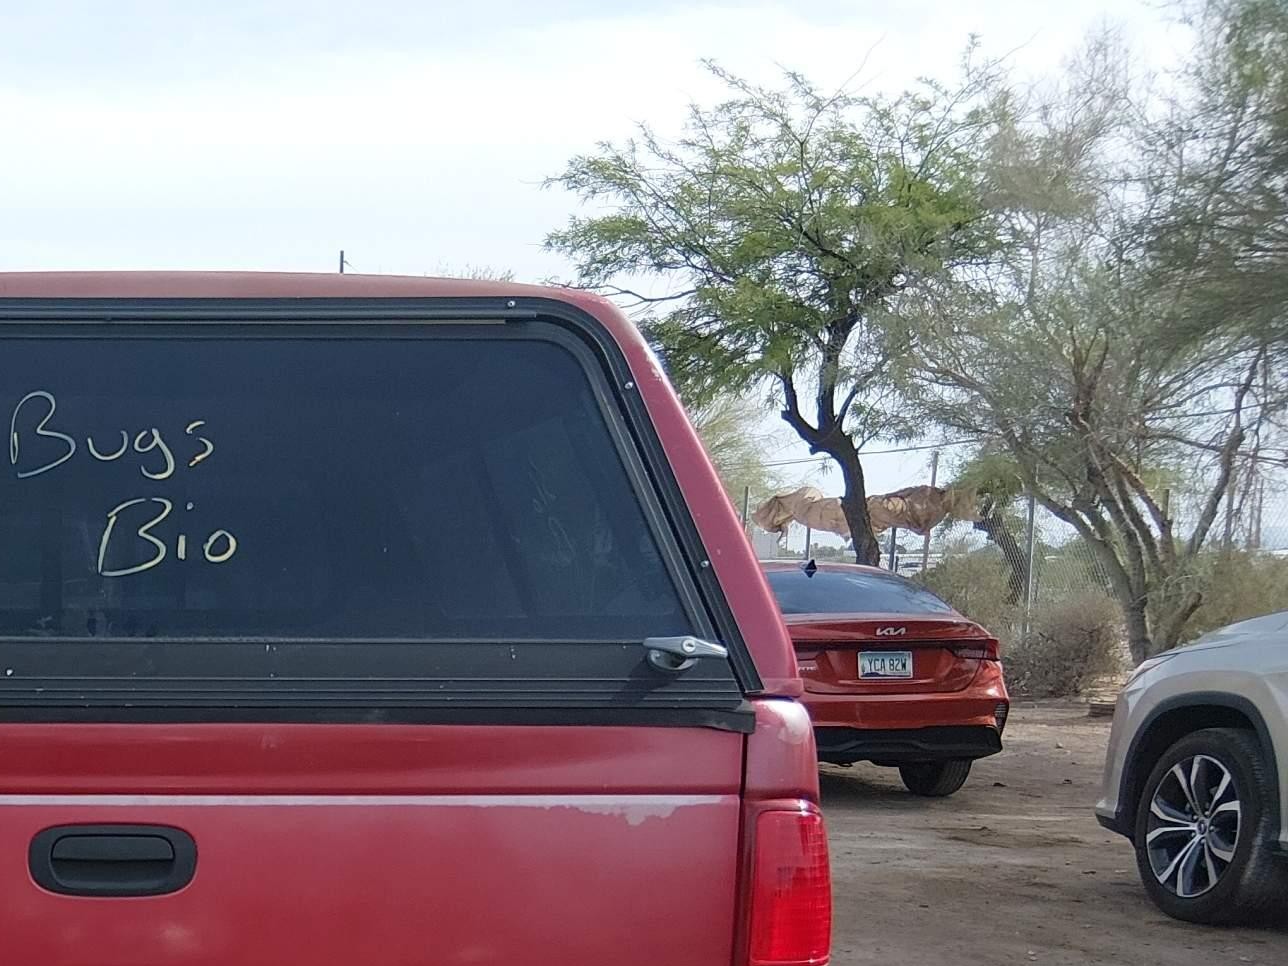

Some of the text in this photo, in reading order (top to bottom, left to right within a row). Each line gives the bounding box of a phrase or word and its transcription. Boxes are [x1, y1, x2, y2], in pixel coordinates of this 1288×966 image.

[10, 390, 215, 480] Bugs
[97, 497, 238, 577] Bio
[867, 658, 907, 672] YCA 82W
